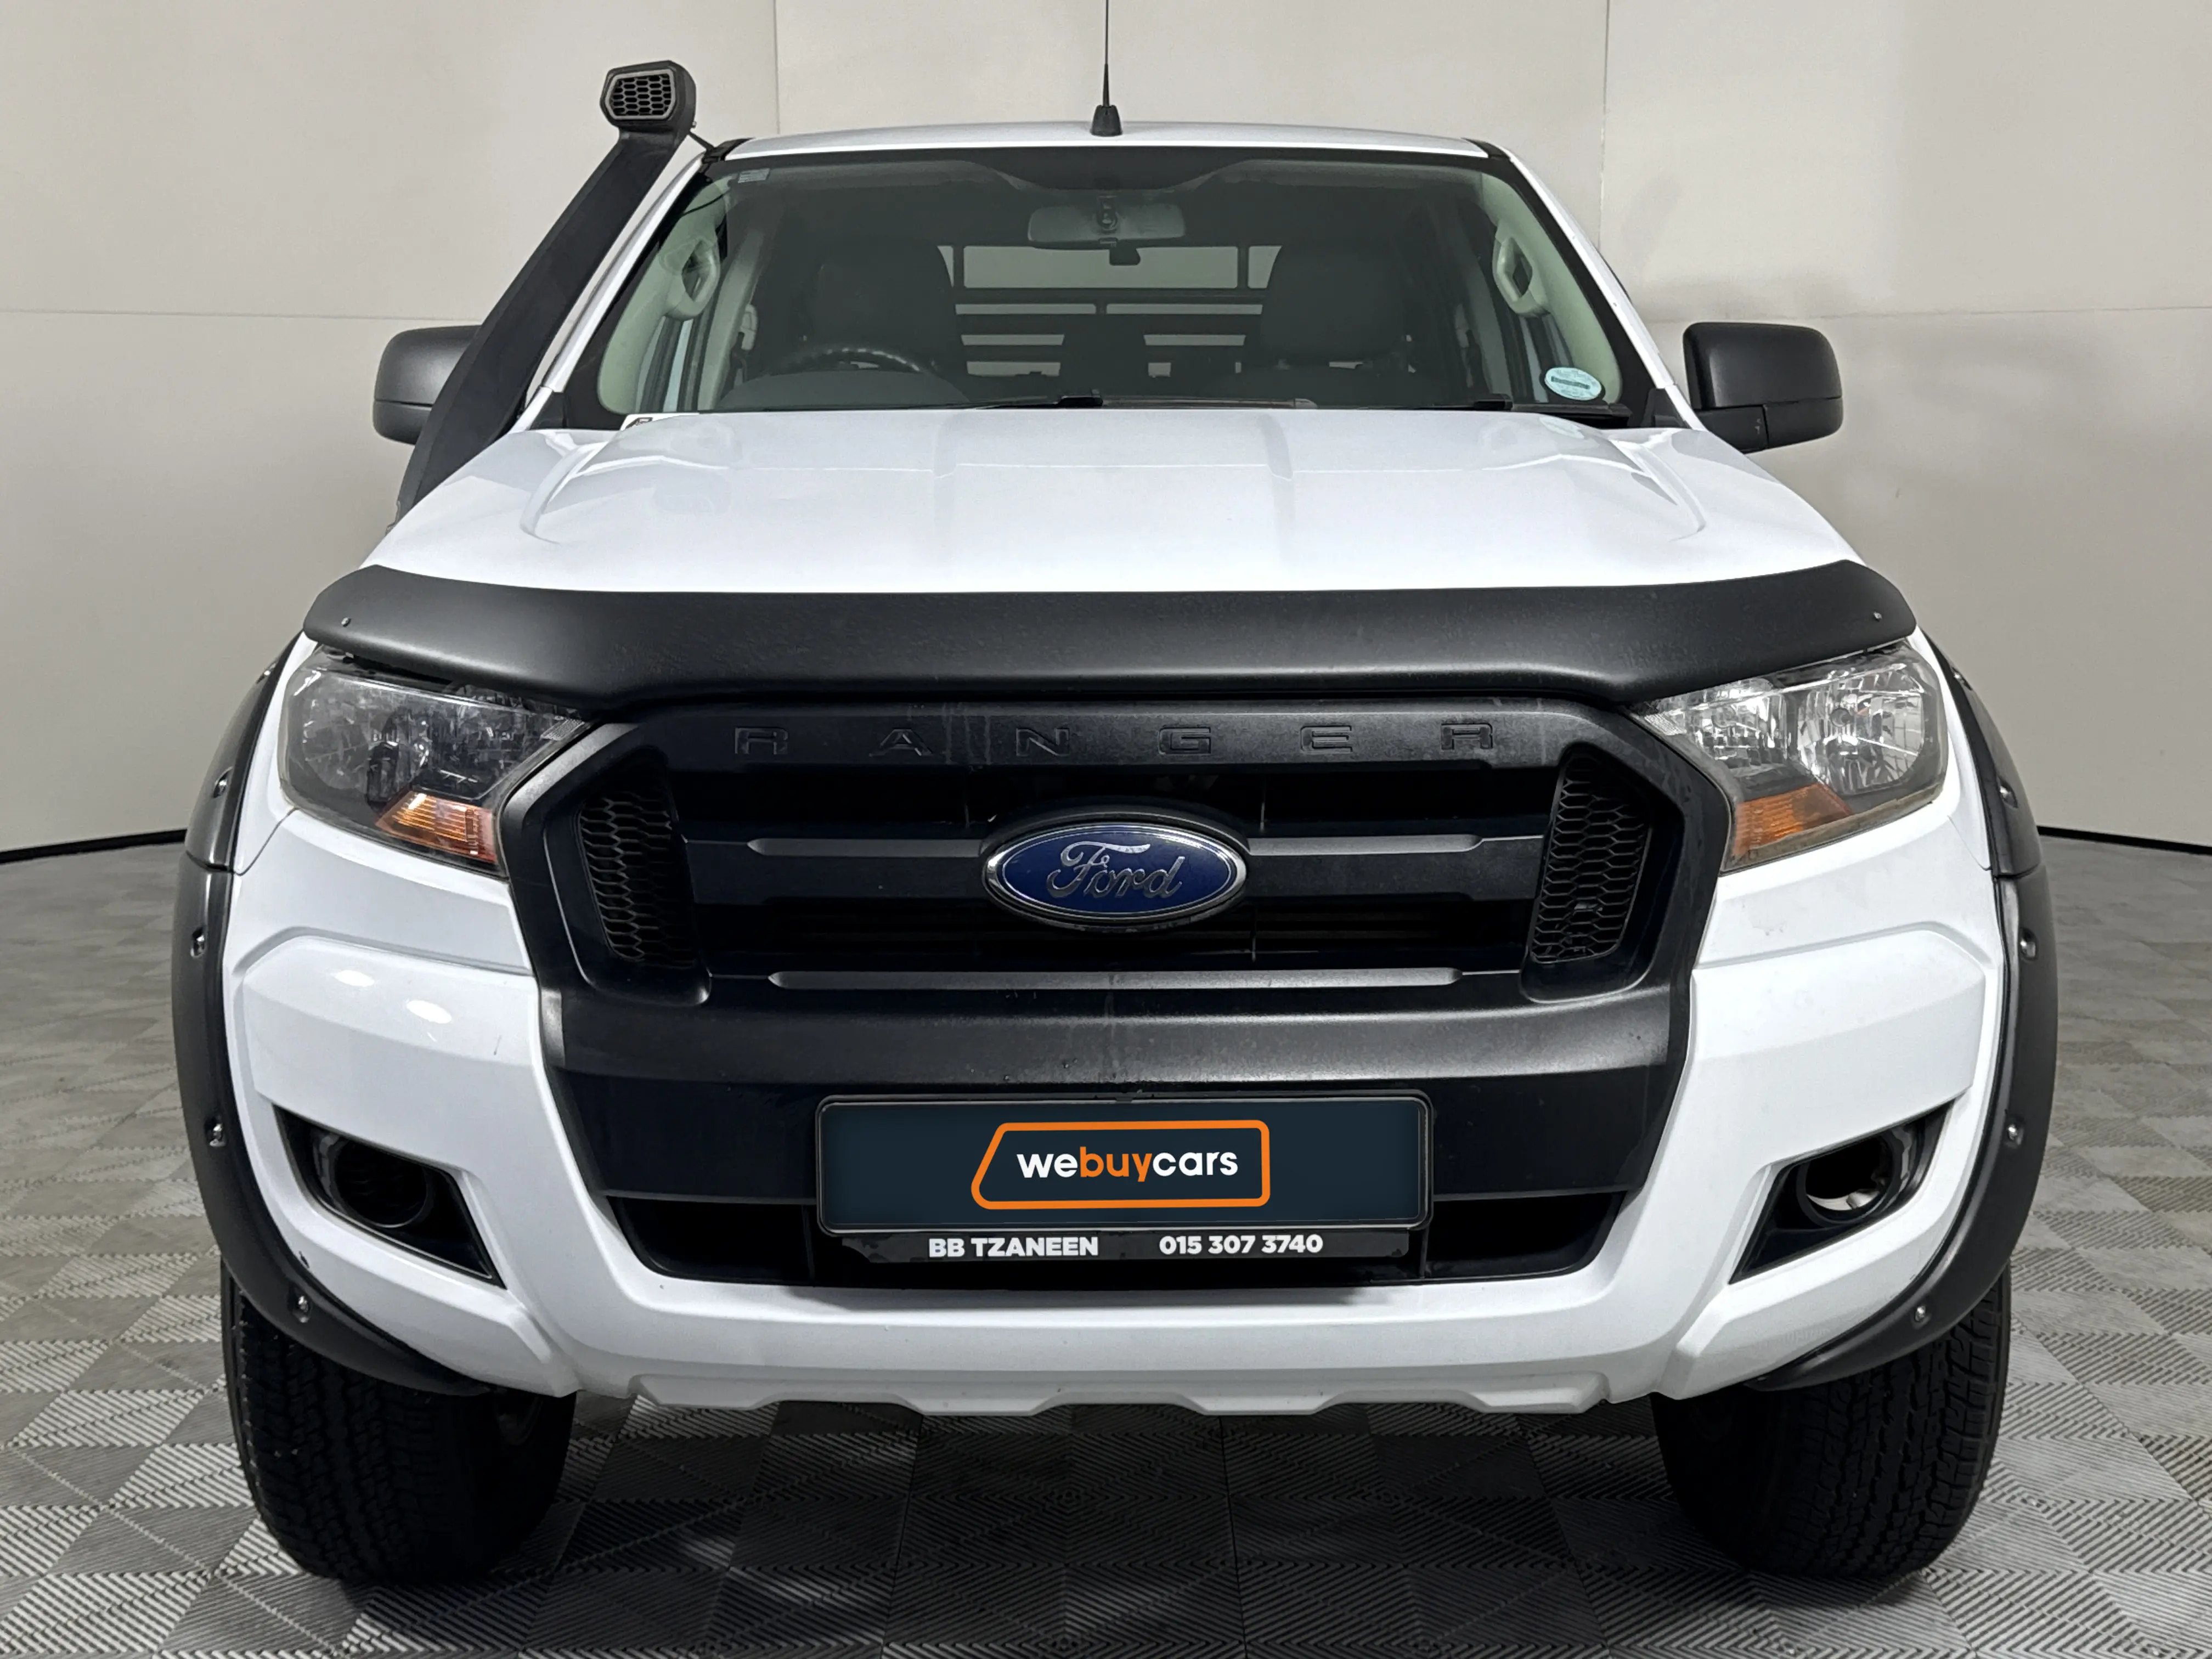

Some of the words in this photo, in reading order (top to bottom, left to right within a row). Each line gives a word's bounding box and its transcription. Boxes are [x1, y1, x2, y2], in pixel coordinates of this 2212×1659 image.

[733, 723, 1494, 757] RANGER
[1047, 841, 1185, 899] Ford
[928, 1238, 965, 1258] BB
[970, 1237, 1098, 1257] TZANEEN
[1159, 1235, 1202, 1255] 015
[1207, 1235, 1256, 1255] 307
[1261, 1234, 1323, 1254] 3740
